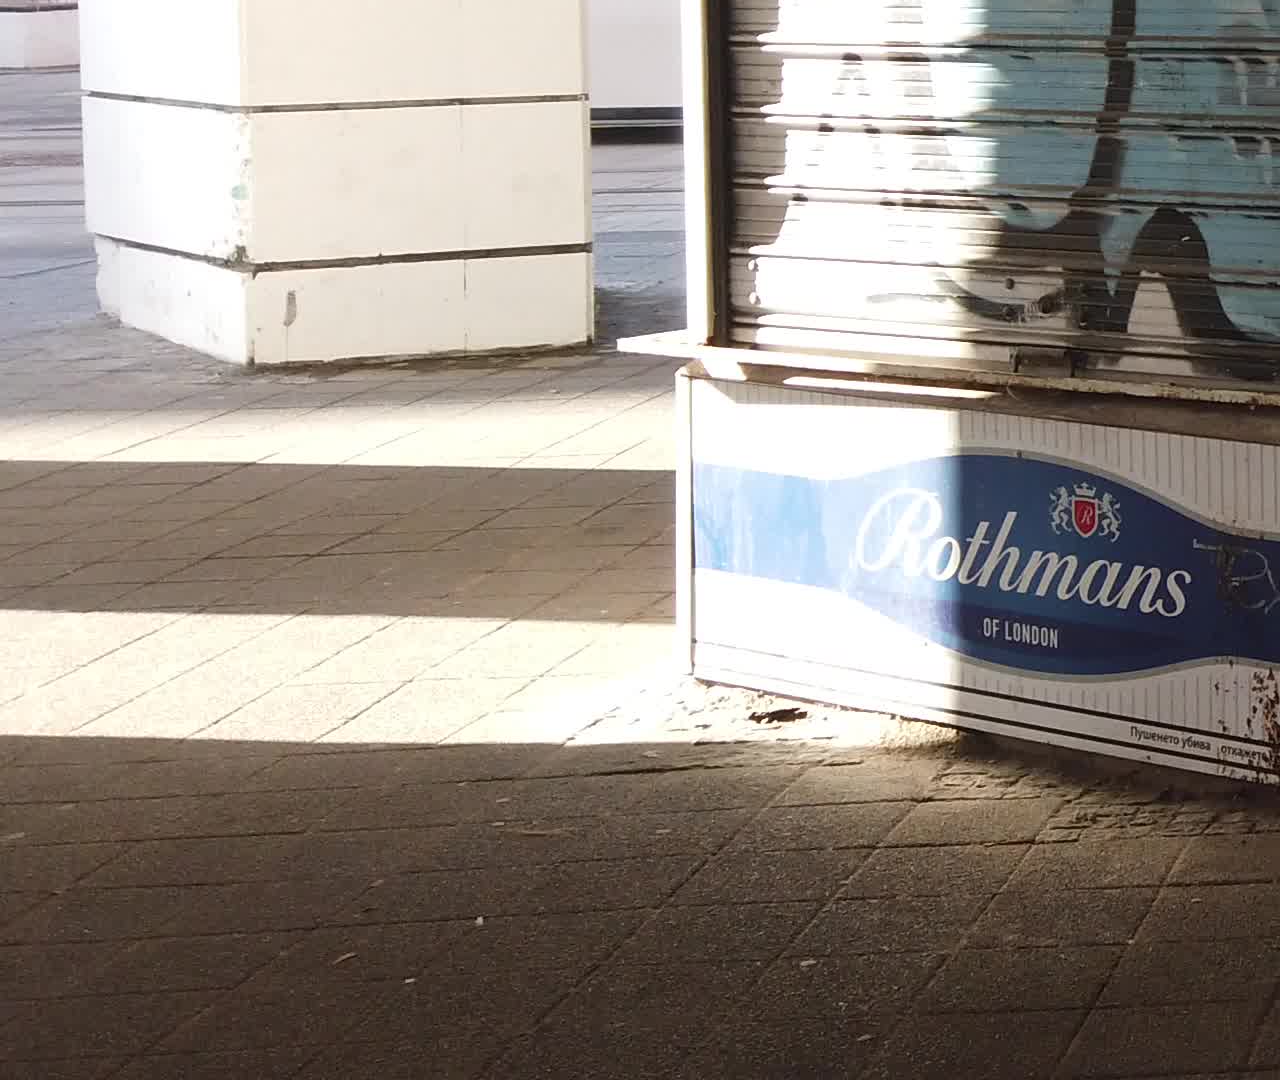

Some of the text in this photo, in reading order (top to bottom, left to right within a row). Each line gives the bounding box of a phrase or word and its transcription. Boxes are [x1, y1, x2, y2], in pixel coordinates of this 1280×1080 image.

[852, 487, 1193, 618] Rothmans
[982, 616, 1059, 649] OF LONDON
[1129, 725, 1180, 745] Пушенето
[1181, 736, 1212, 752] убива
